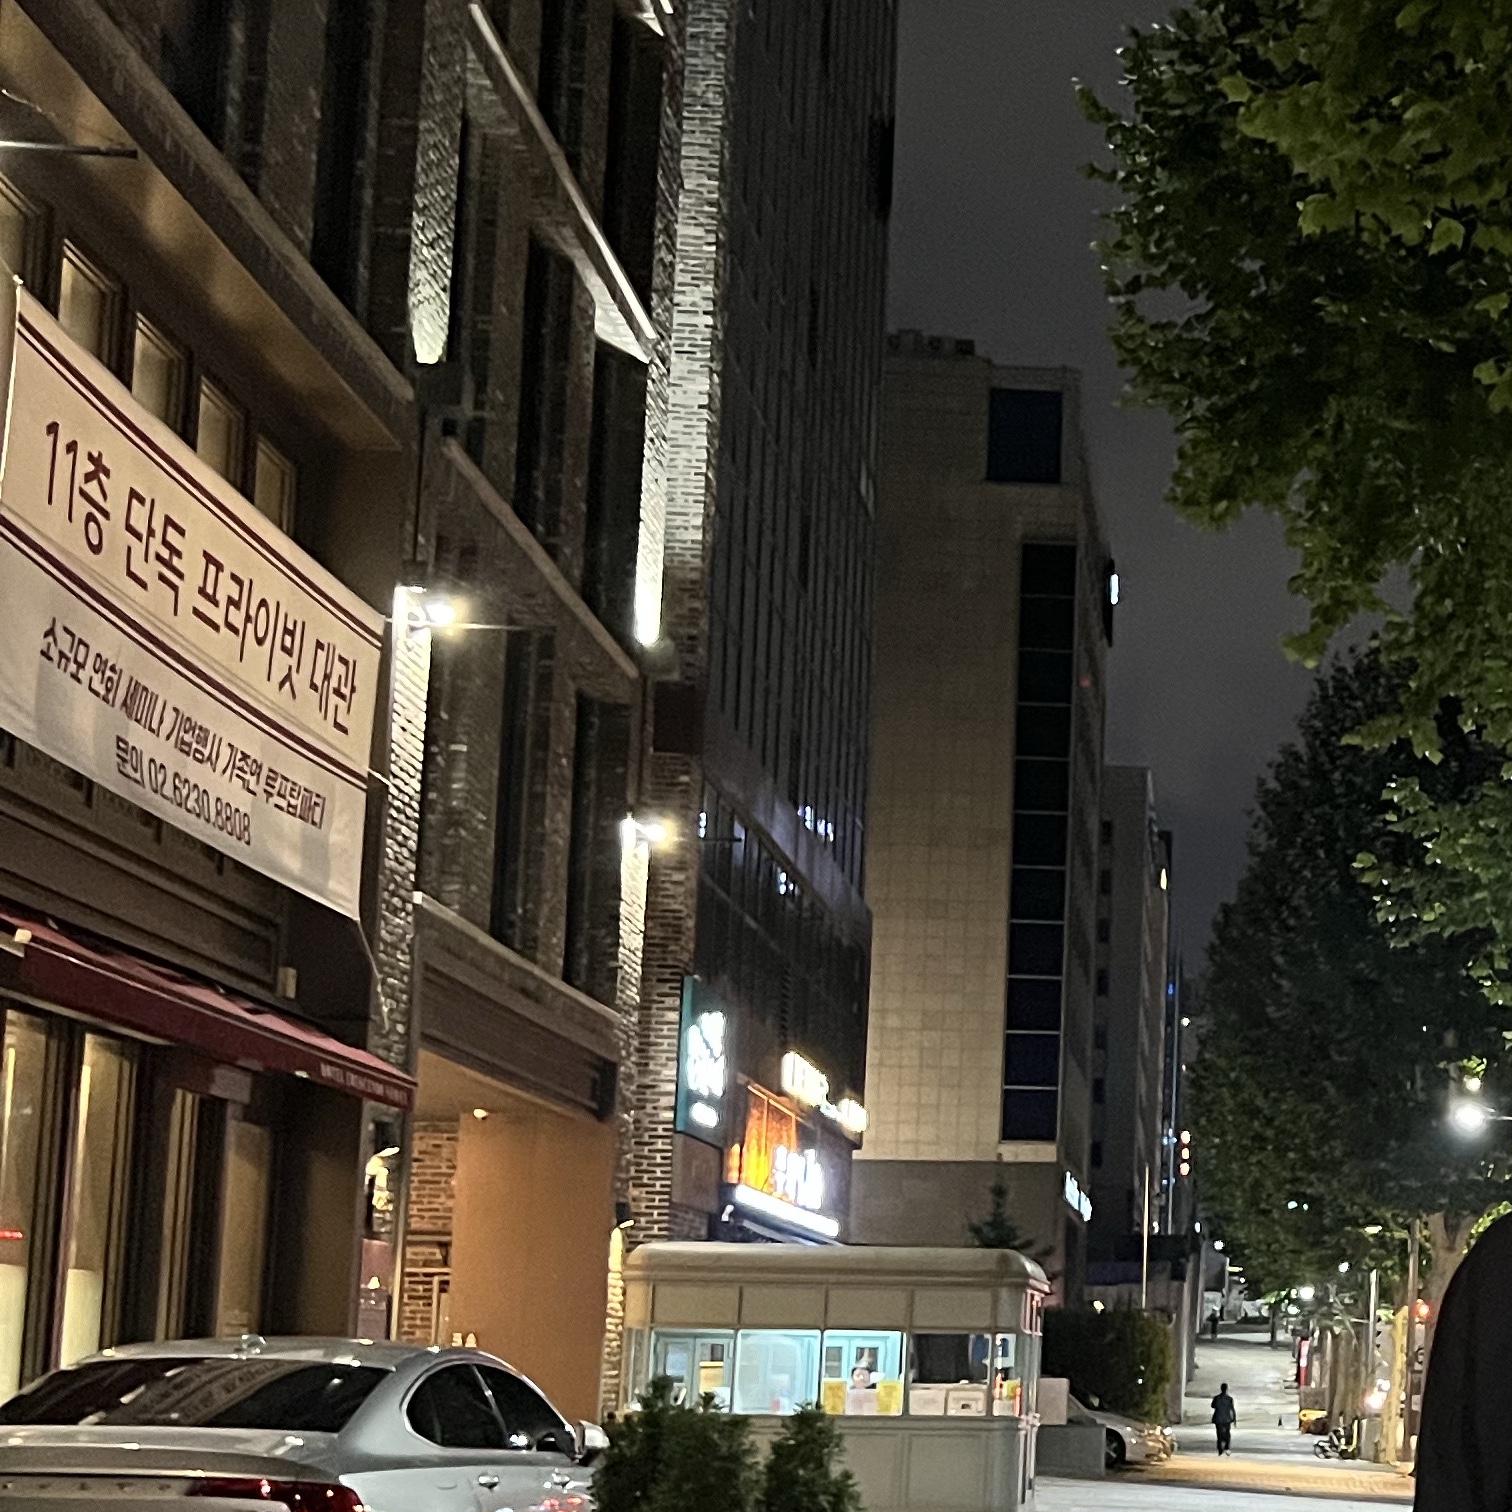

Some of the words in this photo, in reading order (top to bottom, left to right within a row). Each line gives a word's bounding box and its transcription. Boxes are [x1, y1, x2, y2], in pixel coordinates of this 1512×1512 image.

[46, 421, 111, 556] 11층
[125, 486, 187, 617] 단독
[191, 549, 306, 700] 프라이빗
[308, 638, 357, 736] 대관
[39, 616, 91, 685] 소규모
[88, 652, 123, 708] 연회
[120, 675, 168, 738] 세미나
[115, 734, 147, 789] 문의
[148, 757, 252, 846] 02.6230.8808
